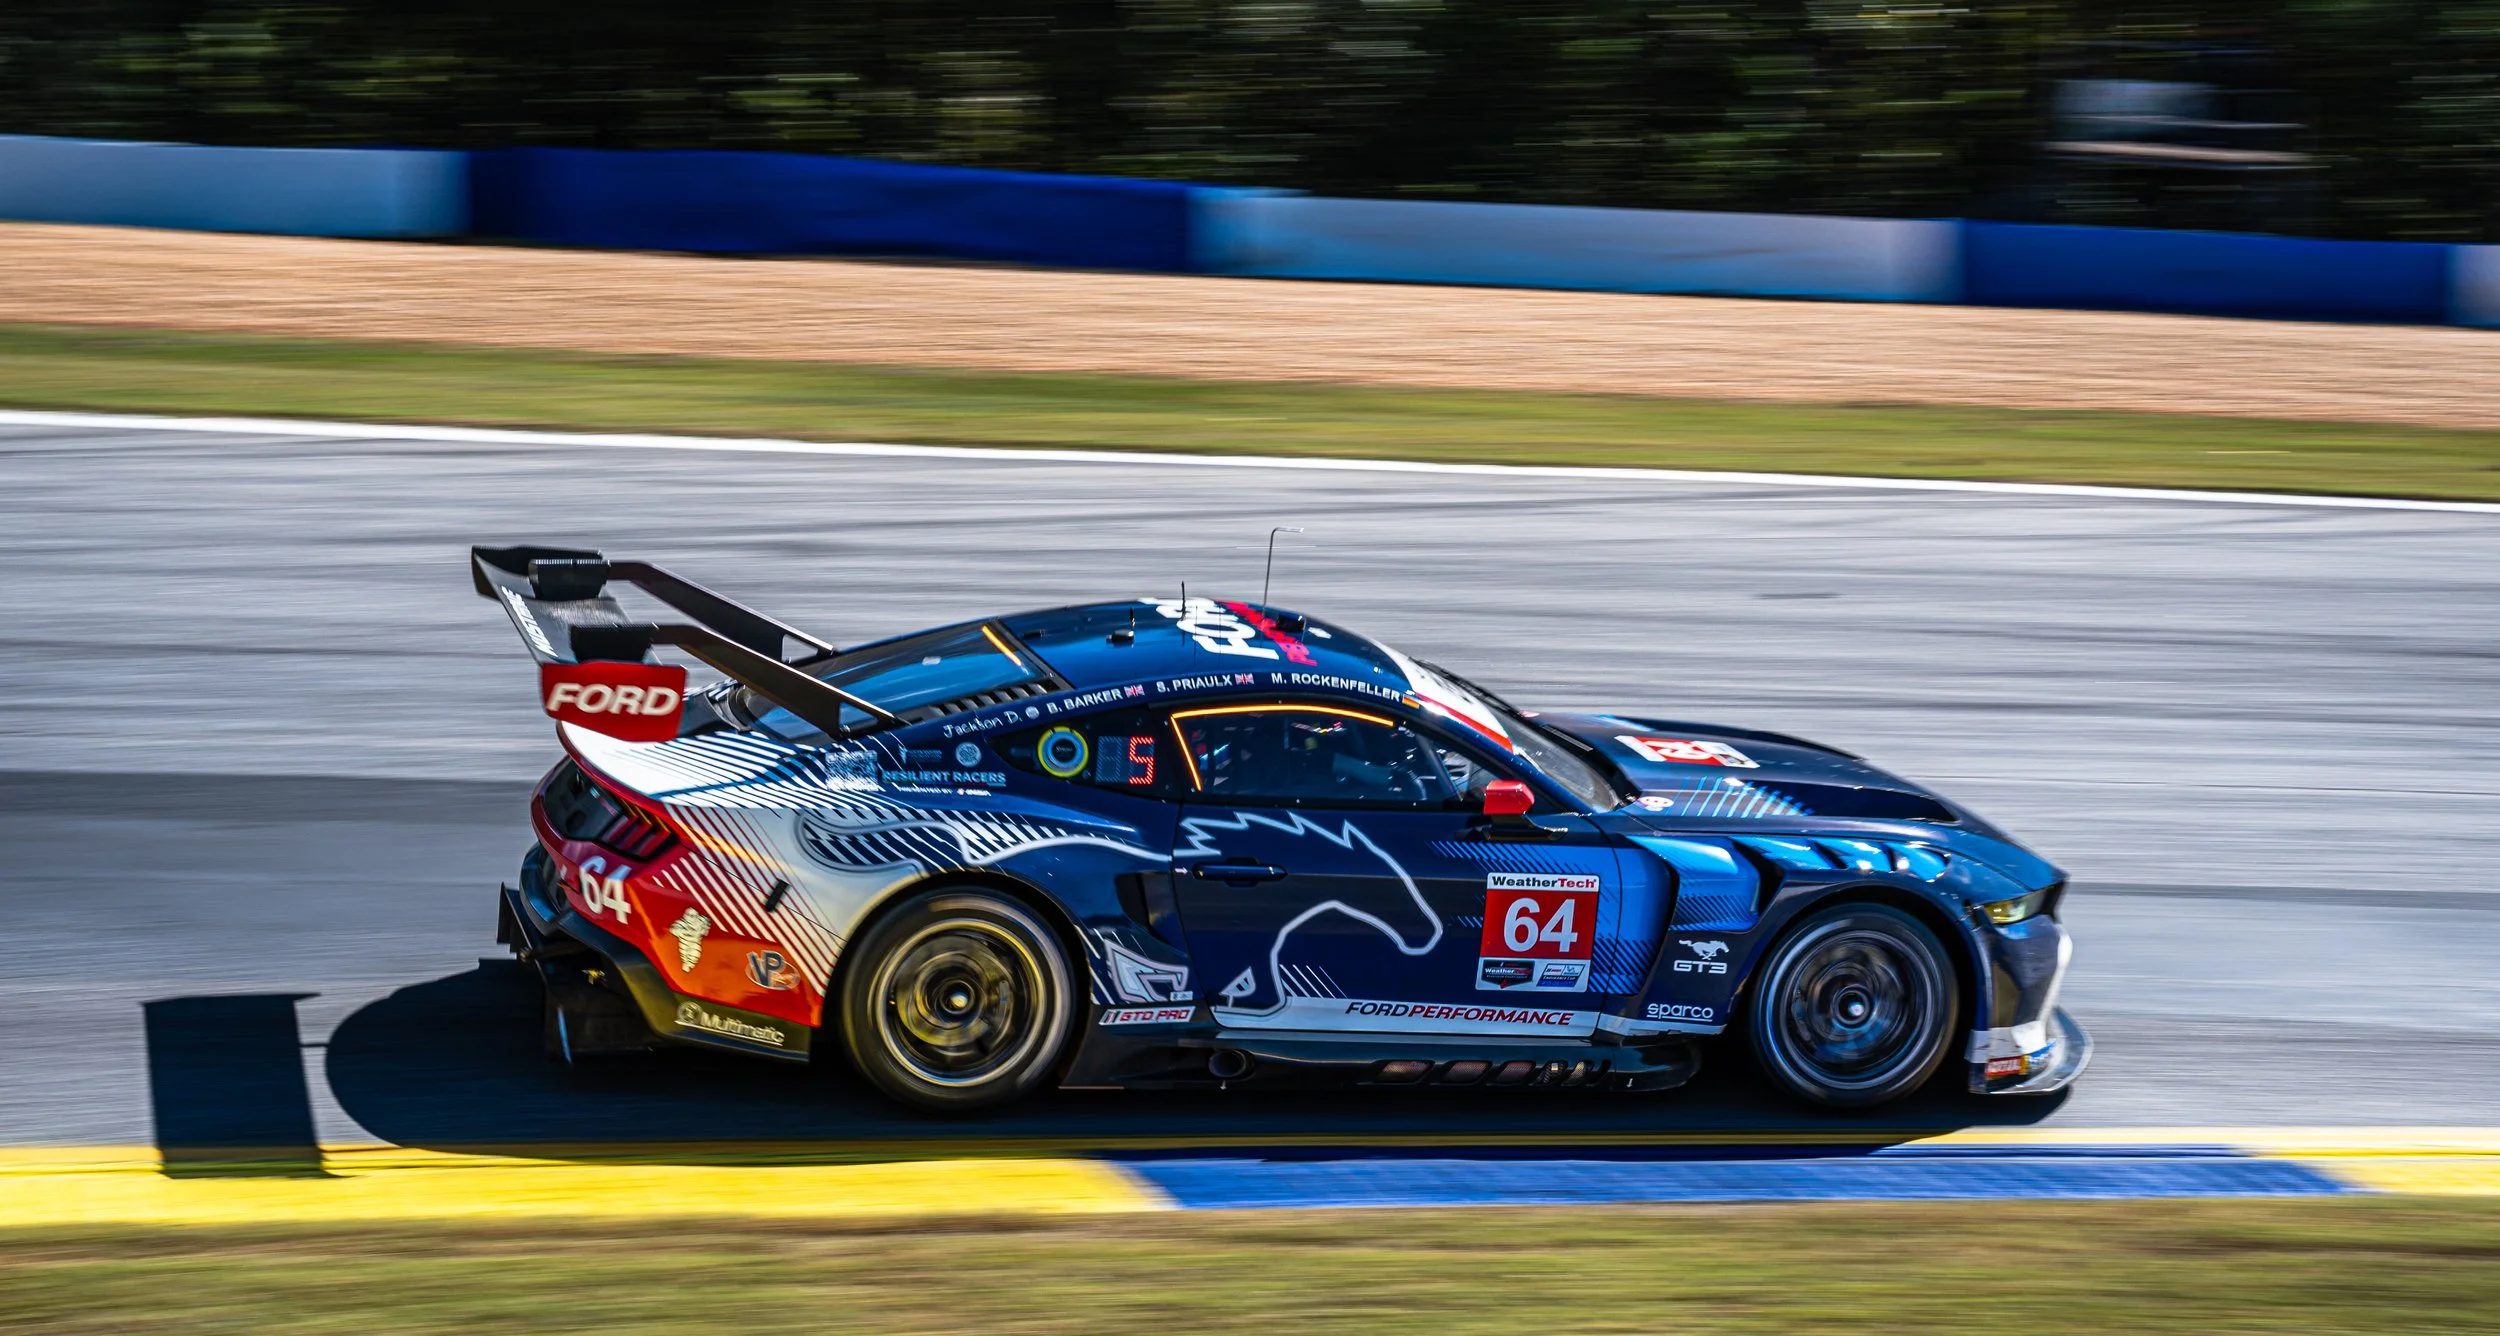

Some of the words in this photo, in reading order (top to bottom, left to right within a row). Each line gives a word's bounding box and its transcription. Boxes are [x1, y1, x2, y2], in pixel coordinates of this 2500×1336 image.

[1156, 681, 1171, 693] S.
[1172, 674, 1233, 691] PRIAULX
[1271, 672, 1287, 684] M.
[1291, 672, 1400, 702] ROCKENFELLER
[546, 682, 681, 716] FORD
[1046, 702, 1063, 714] B.
[1063, 688, 1123, 710] BARKER
[942, 715, 1004, 738] Jackson
[1003, 710, 1023, 724] D.
[882, 771, 951, 783] RESILIENT
[952, 771, 1006, 784] RACERS
[579, 855, 632, 925] 64
[1492, 876, 1596, 888] WeatherTech
[1503, 897, 1578, 953] 64
[747, 951, 784, 987] VP
[1673, 960, 1727, 974] GT3
[1120, 1010, 1154, 1022] GTD
[1156, 1009, 1190, 1022] PRO
[1647, 1003, 1714, 1019] sparco
